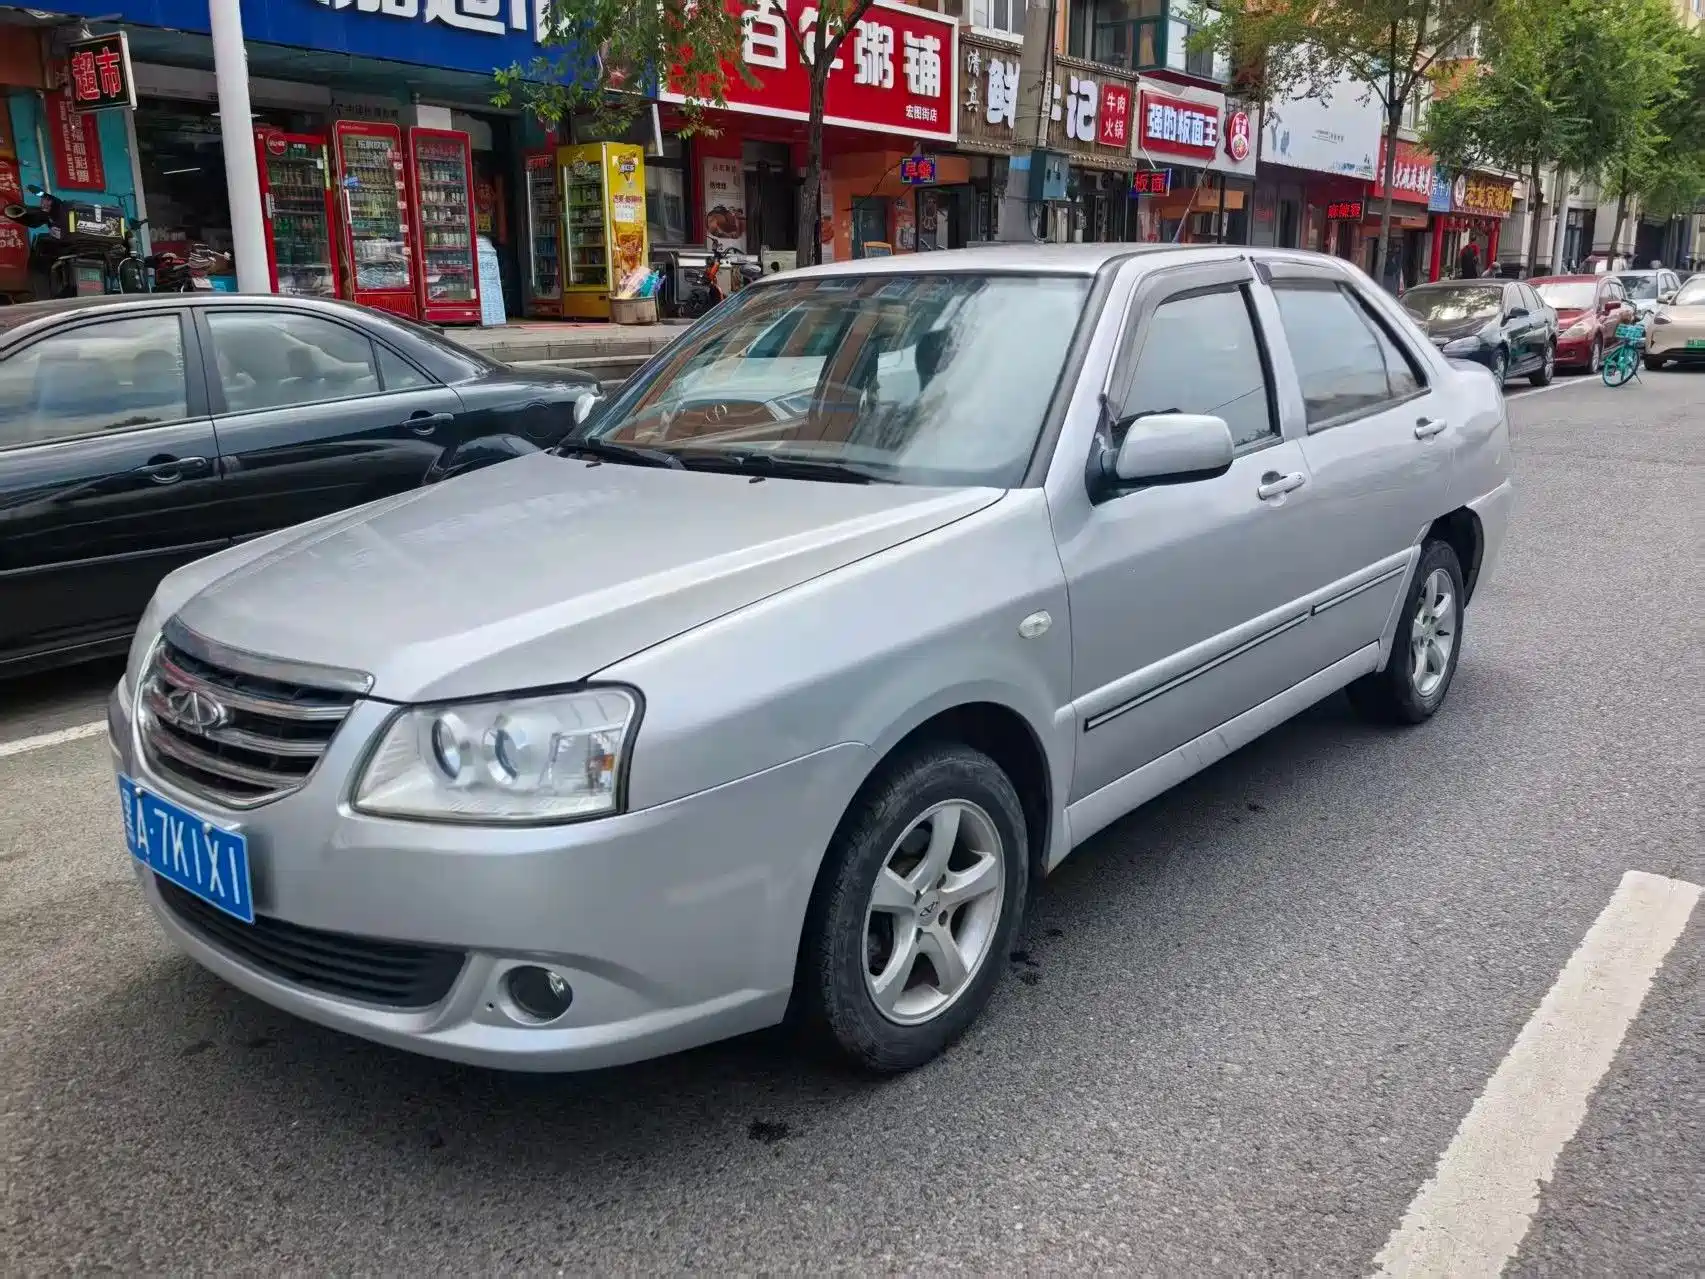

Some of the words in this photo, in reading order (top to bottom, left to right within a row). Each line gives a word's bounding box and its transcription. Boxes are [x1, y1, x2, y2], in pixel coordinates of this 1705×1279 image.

[71, 46, 122, 101] 超市
[965, 49, 981, 112] 清真
[905, 104, 938, 123] 宏图街店
[1106, 93, 1126, 114] 牛肉
[1104, 119, 1125, 139] 火锅
[1135, 173, 1166, 192] 板面
